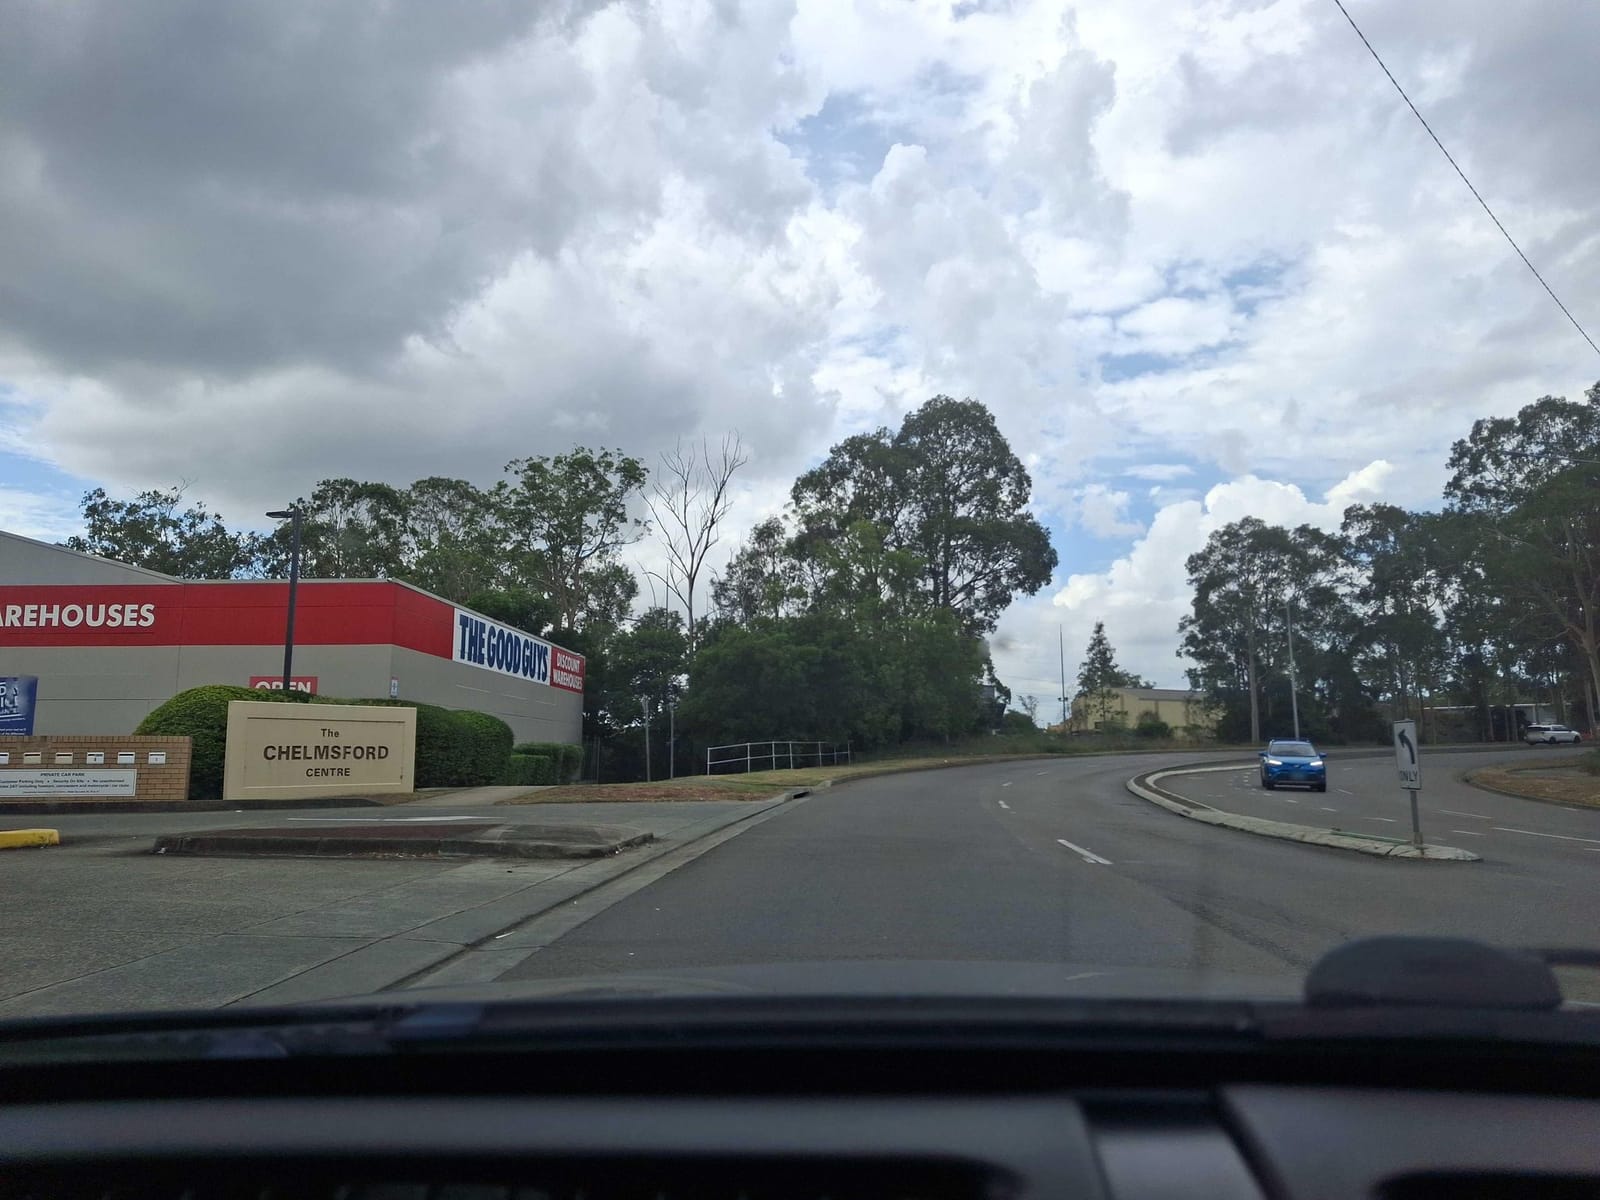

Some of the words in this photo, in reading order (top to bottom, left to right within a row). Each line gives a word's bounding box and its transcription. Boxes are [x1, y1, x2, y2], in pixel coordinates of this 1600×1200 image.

[0, 604, 155, 627] REHOUSES
[459, 613, 486, 665] THE
[487, 625, 521, 674] GOOD
[521, 638, 548, 682] GUYS
[556, 652, 580, 673] DISCOUNT
[553, 669, 583, 690] WAREHOUSES
[321, 728, 340, 738] The
[263, 745, 389, 761] CHELMSFORD
[306, 767, 351, 777] CENTRE
